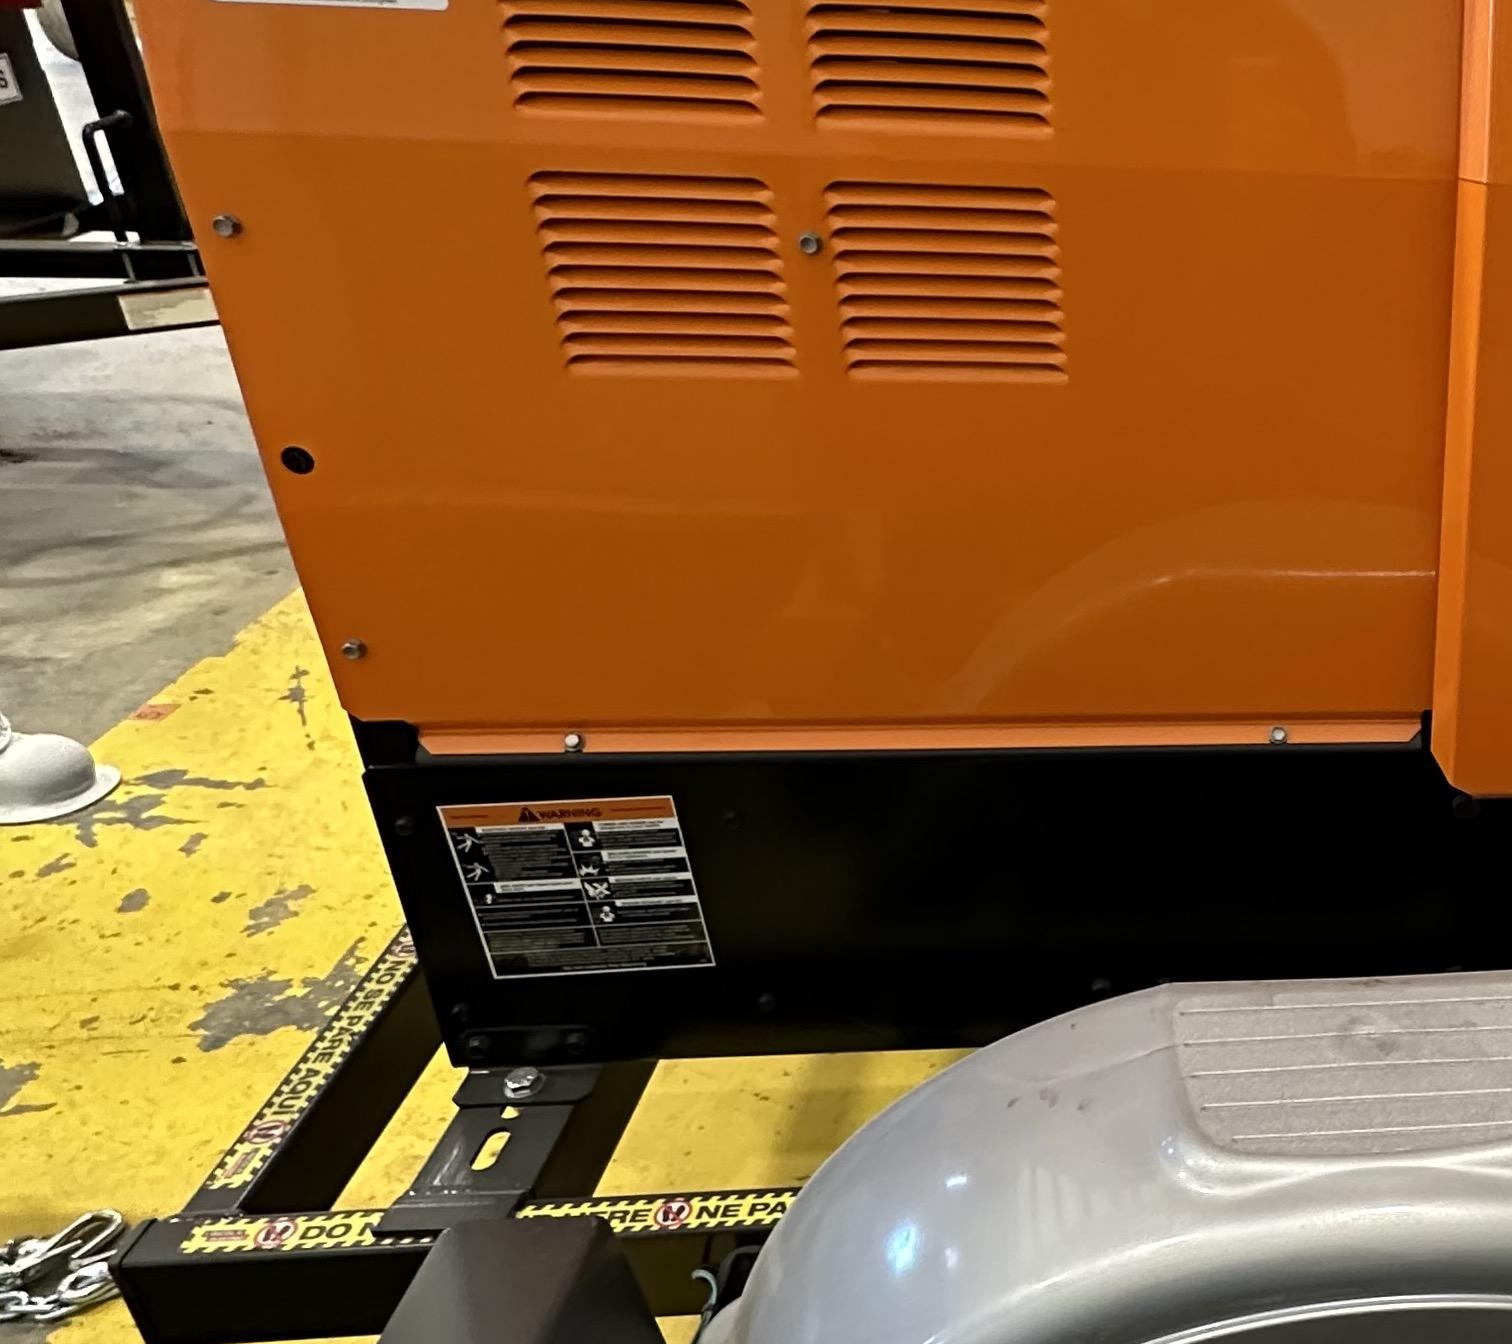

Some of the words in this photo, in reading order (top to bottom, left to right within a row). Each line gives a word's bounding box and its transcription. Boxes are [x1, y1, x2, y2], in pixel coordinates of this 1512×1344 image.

[538, 807, 603, 819] WARNING
[376, 959, 407, 986] NO
[356, 988, 381, 1012] SE
[313, 1015, 361, 1064] PARE
[273, 1067, 321, 1115] AQUI
[696, 1203, 743, 1219] NE
[299, 1223, 353, 1240] DO
